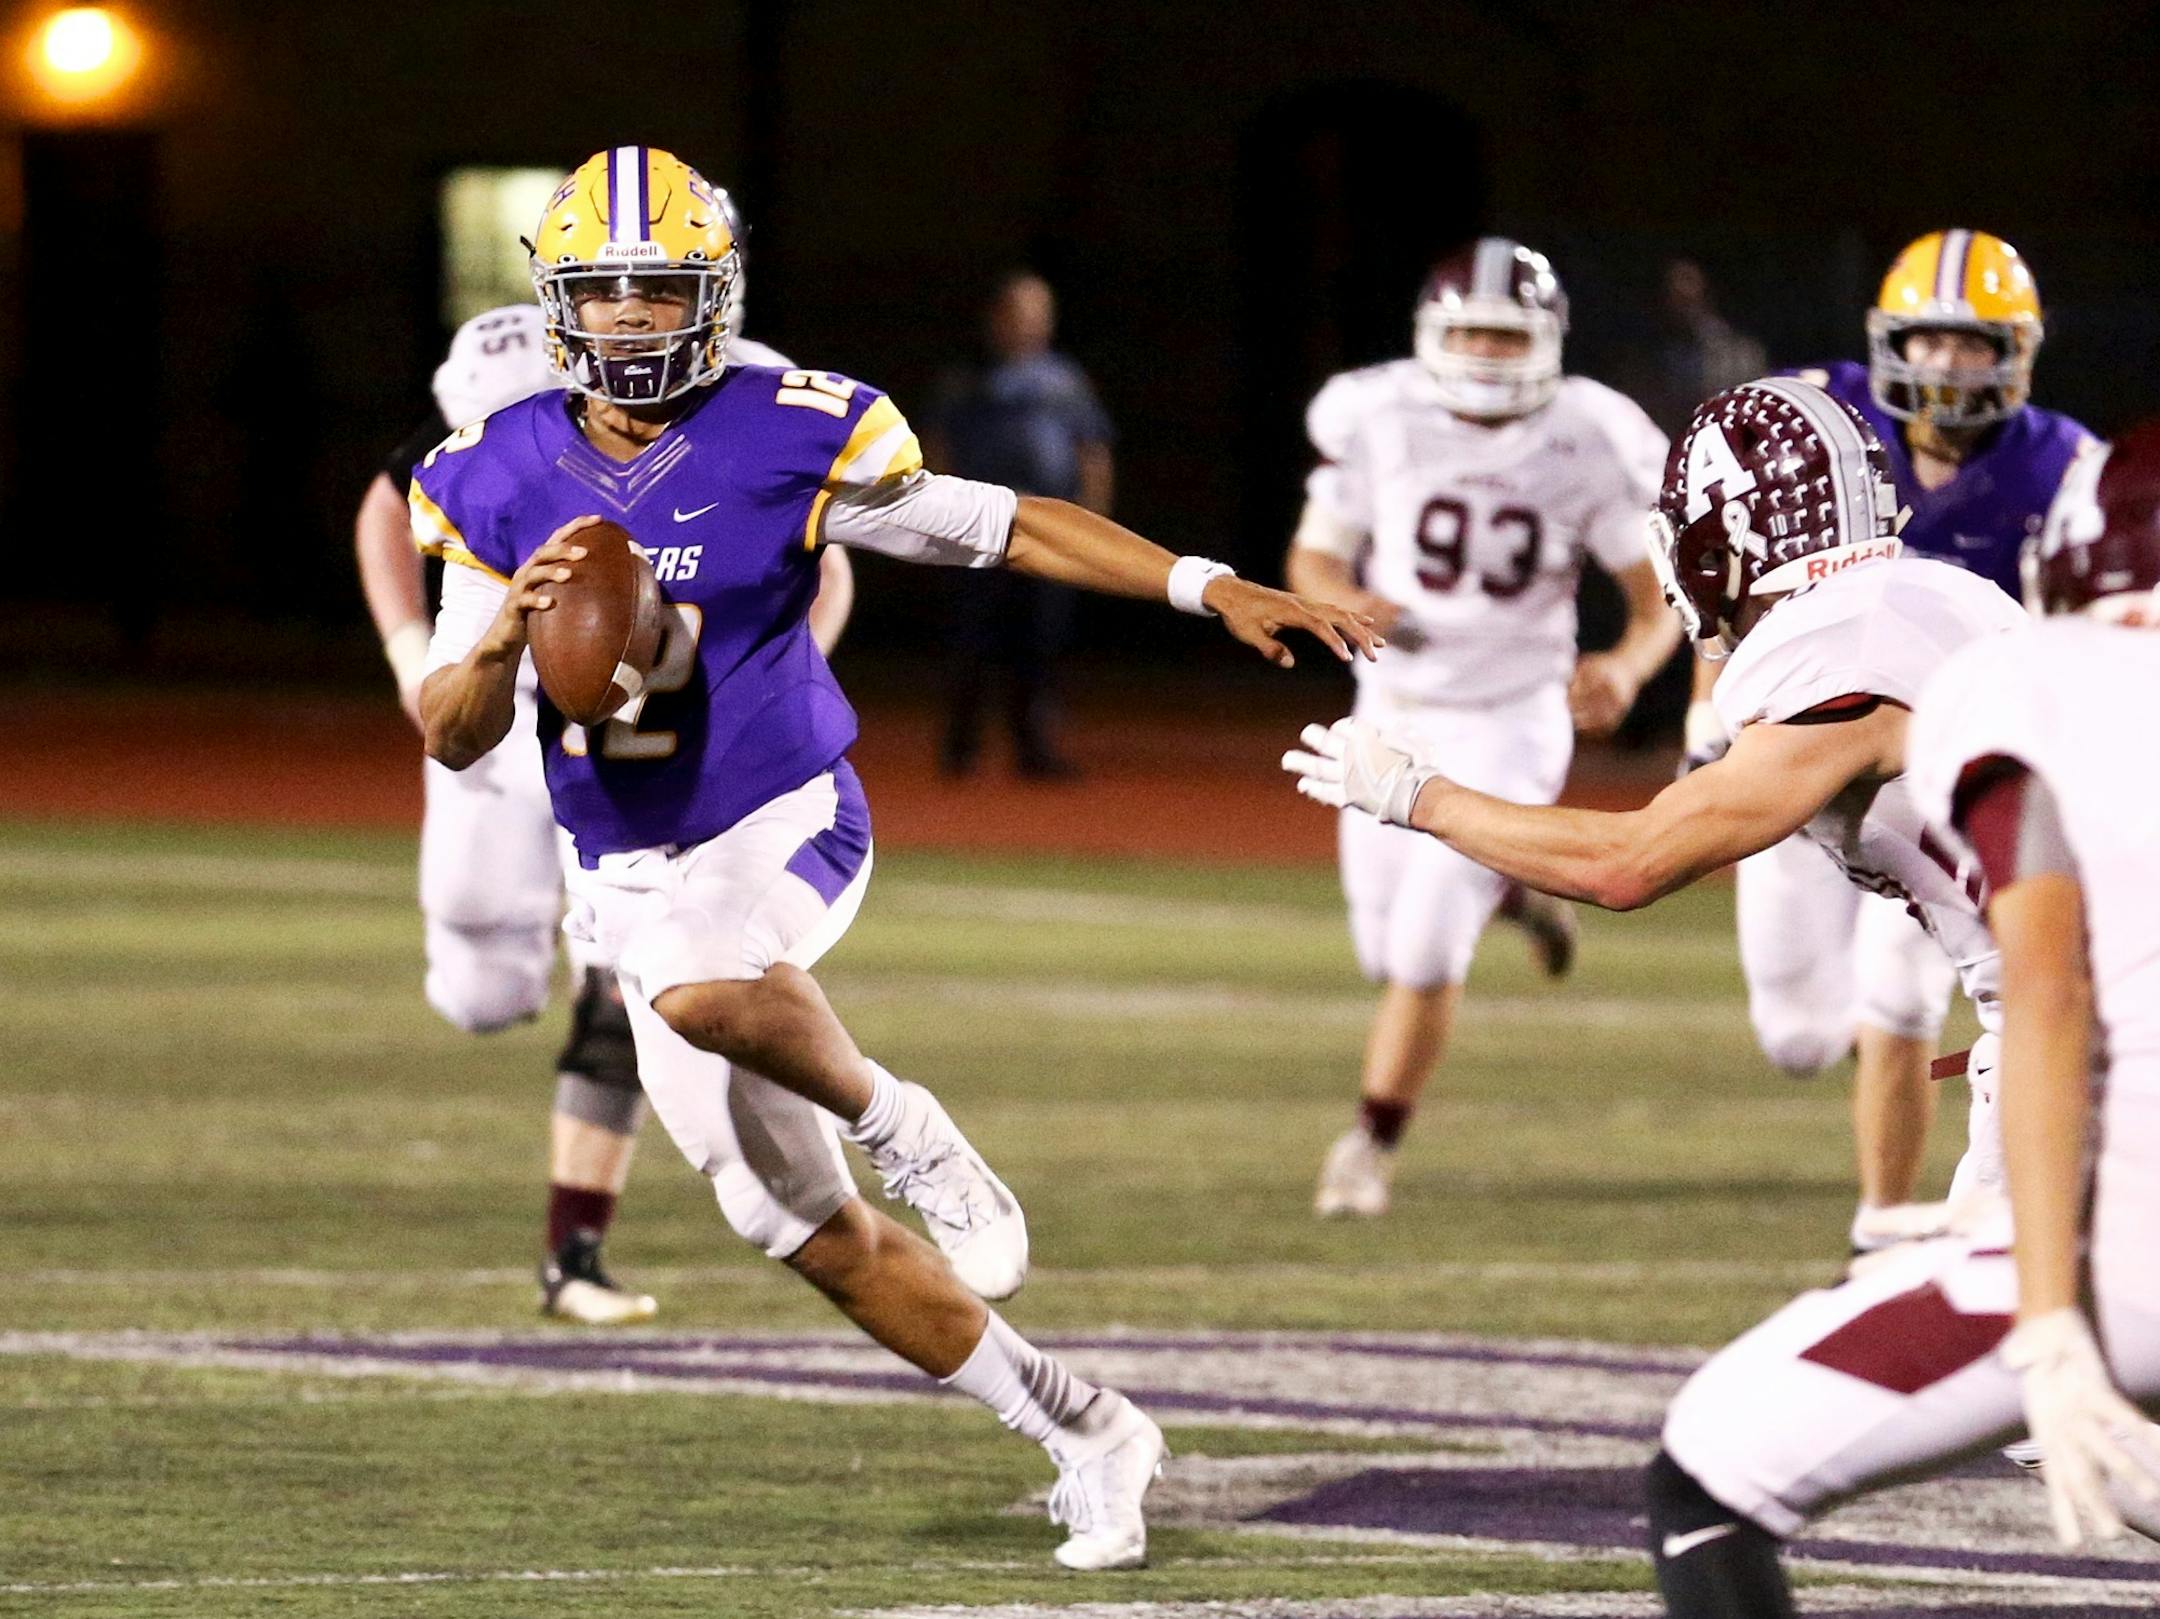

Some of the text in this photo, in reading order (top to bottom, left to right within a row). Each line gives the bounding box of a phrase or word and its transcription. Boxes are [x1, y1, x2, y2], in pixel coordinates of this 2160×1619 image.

[605, 246, 657, 257] Riddell
[775, 370, 857, 419] 12
[1684, 422, 1758, 525] A
[1414, 495, 1543, 600] 93
[1768, 514, 1788, 537] 10
[561, 602, 702, 760] 2
